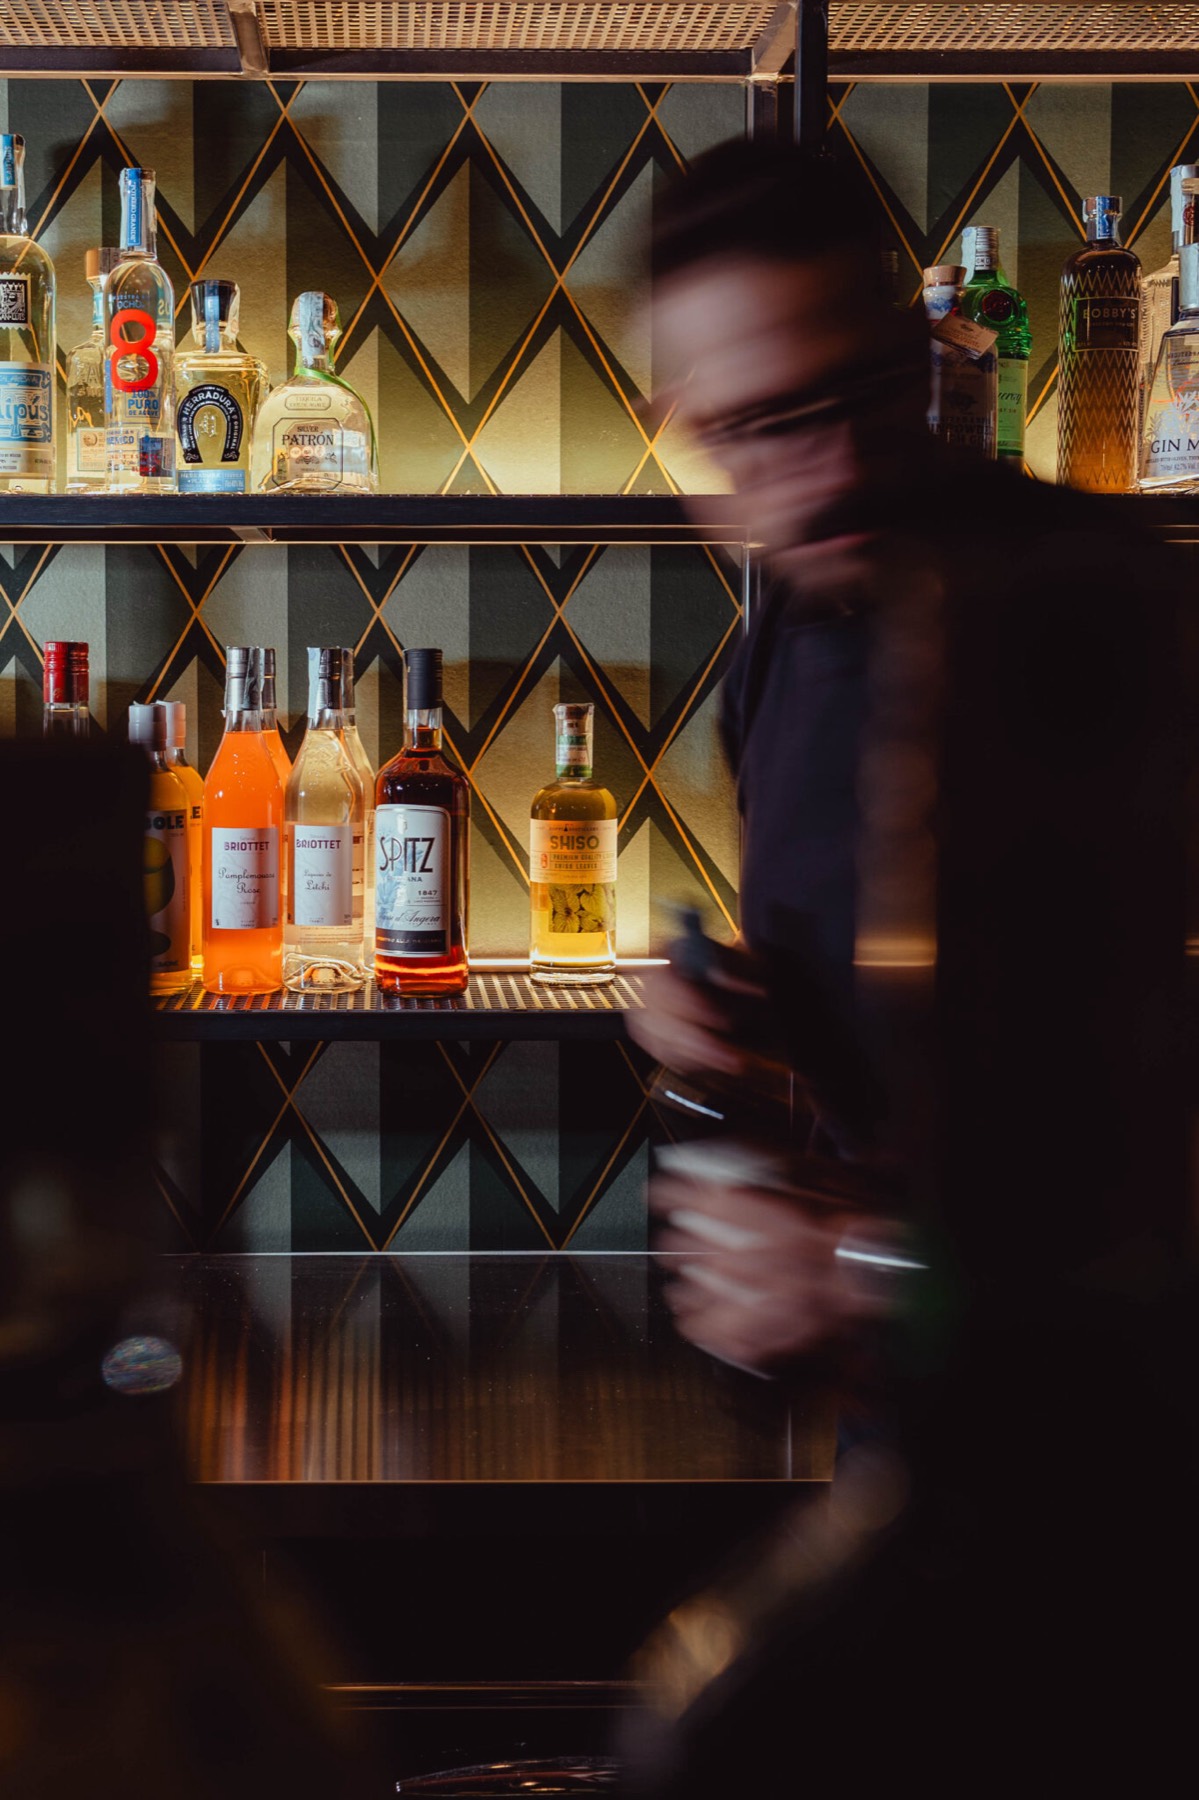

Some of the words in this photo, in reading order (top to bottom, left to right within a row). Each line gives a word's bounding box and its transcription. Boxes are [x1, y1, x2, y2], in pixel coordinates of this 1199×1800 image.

[110, 309, 158, 393] 8
[127, 399, 159, 410] PURO
[182, 391, 236, 415] HERRADURA
[282, 431, 335, 446] PATRÓN
[1150, 438, 1181, 454] GIN
[1187, 437, 1199, 452] M
[224, 841, 270, 851] BRIOTTET
[296, 839, 342, 850] BRIOTTET
[550, 835, 600, 850] SHISO
[379, 836, 436, 873] SPITZ
[236, 882, 262, 894] Rose
